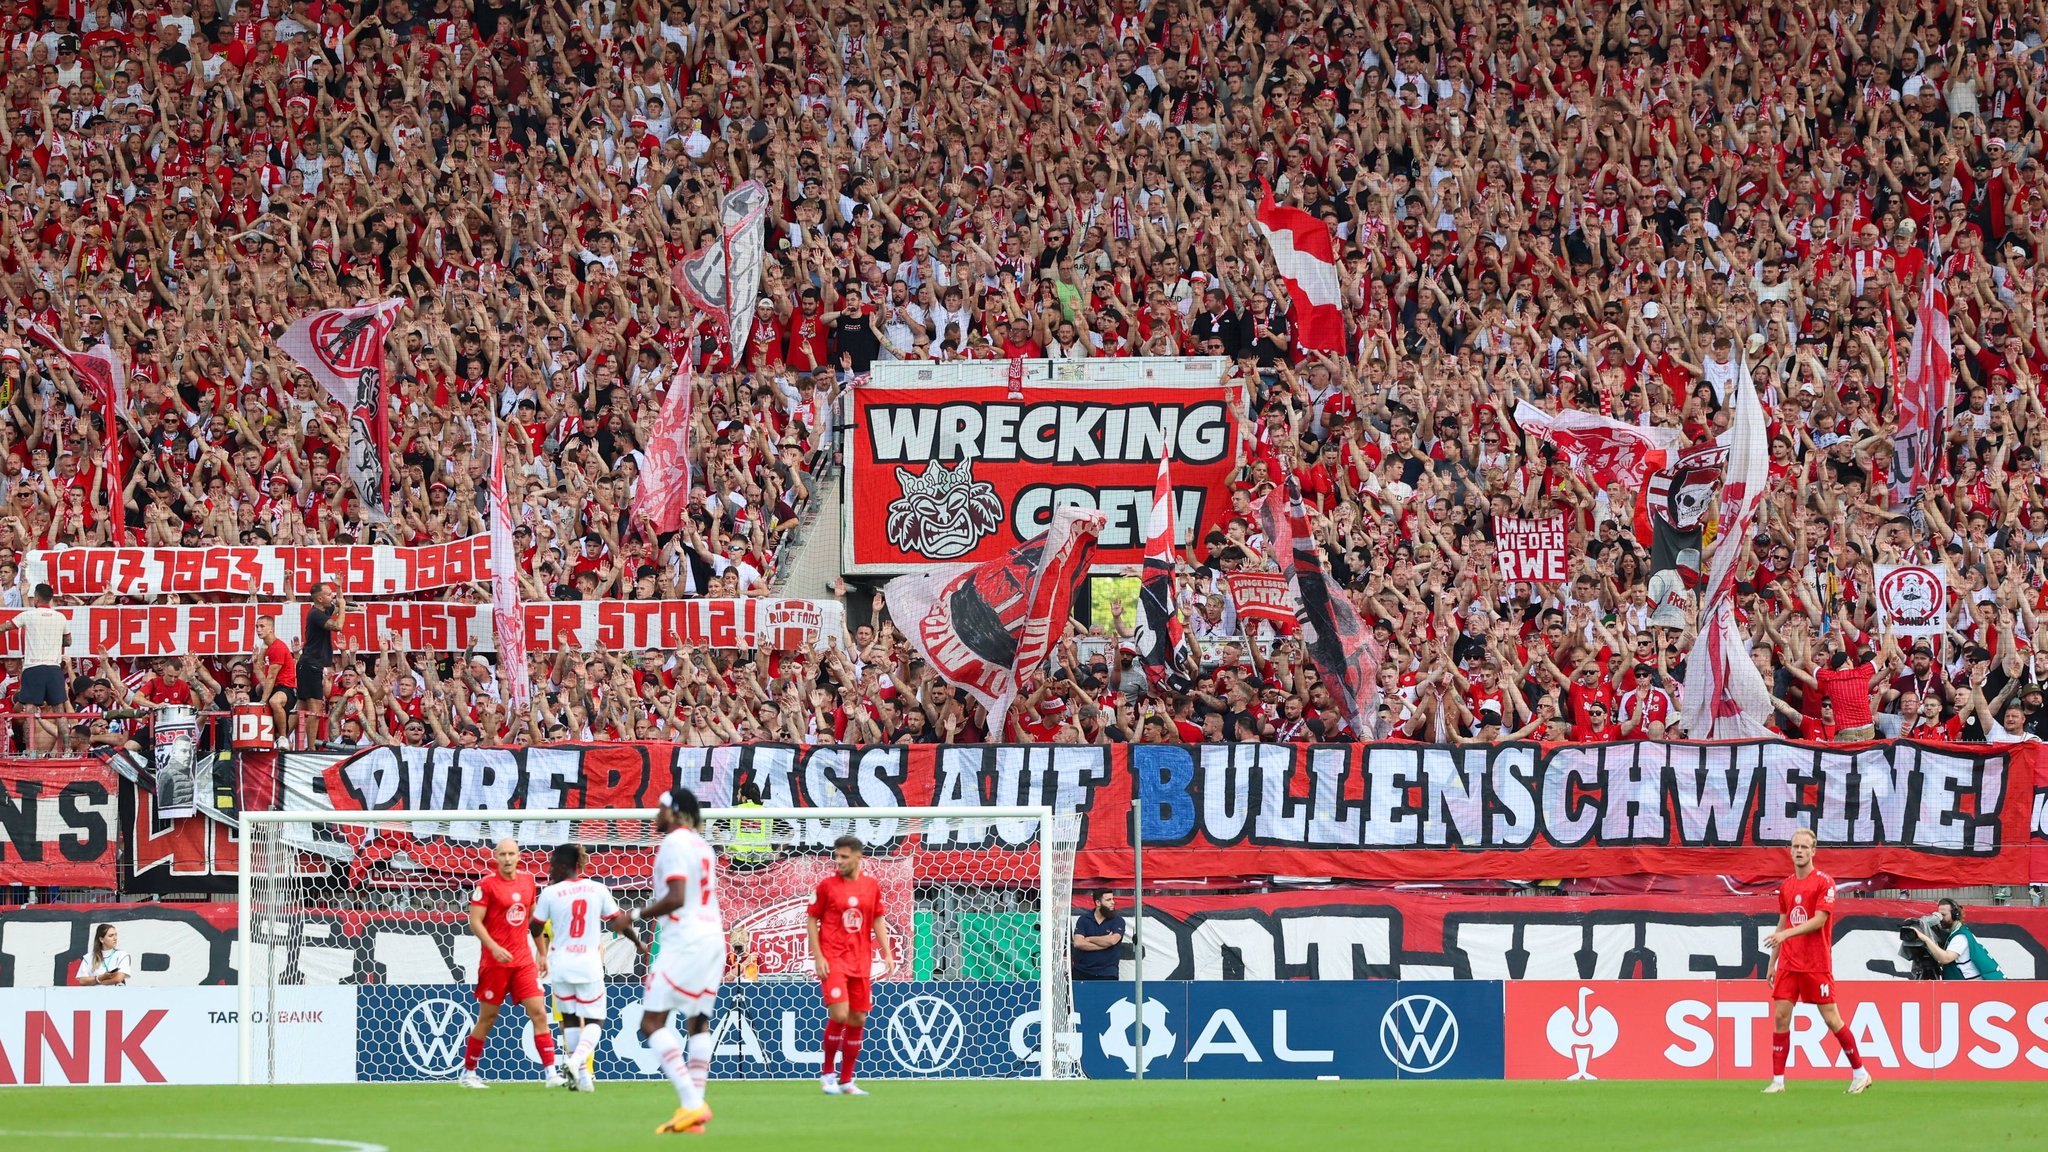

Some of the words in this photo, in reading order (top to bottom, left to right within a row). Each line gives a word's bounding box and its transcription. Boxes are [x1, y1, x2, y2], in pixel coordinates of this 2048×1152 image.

[867, 403, 1228, 463] WRECKING
[1495, 513, 1564, 534] IMMER
[1496, 532, 1565, 552] WIEDER
[1498, 550, 1566, 580] RWE
[89, 606, 177, 656] DER
[493, 603, 582, 652] ER
[598, 598, 757, 649] STOLZ!
[769, 610, 795, 625] RUDE
[797, 611, 821, 626] FANS
[343, 745, 645, 846] PURER
[676, 745, 901, 848] HASS
[927, 746, 1105, 846] AUF
[1133, 741, 2005, 852] BULLENSCHWEINE!
[568, 898, 588, 939] 8
[1819, 983, 1830, 998] 14
[0, 1009, 169, 1083] NK
